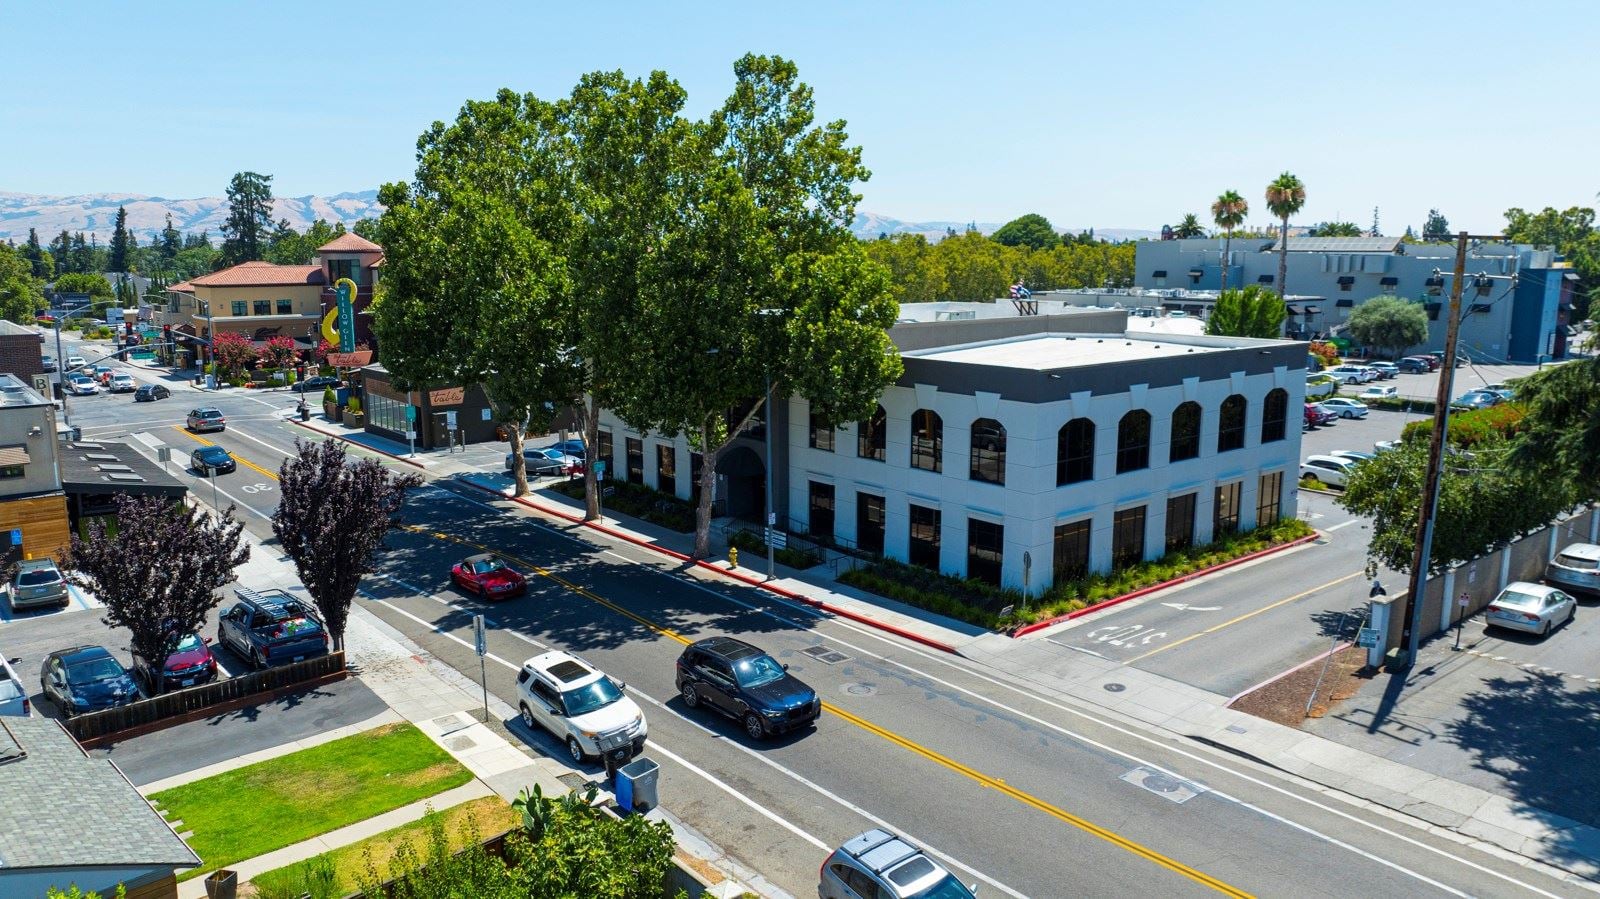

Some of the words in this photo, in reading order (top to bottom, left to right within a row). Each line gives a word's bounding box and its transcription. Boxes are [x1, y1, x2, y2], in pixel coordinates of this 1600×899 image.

[340, 289, 348, 325] WILLOW
[434, 391, 462, 403] table
[241, 483, 273, 494] 30
